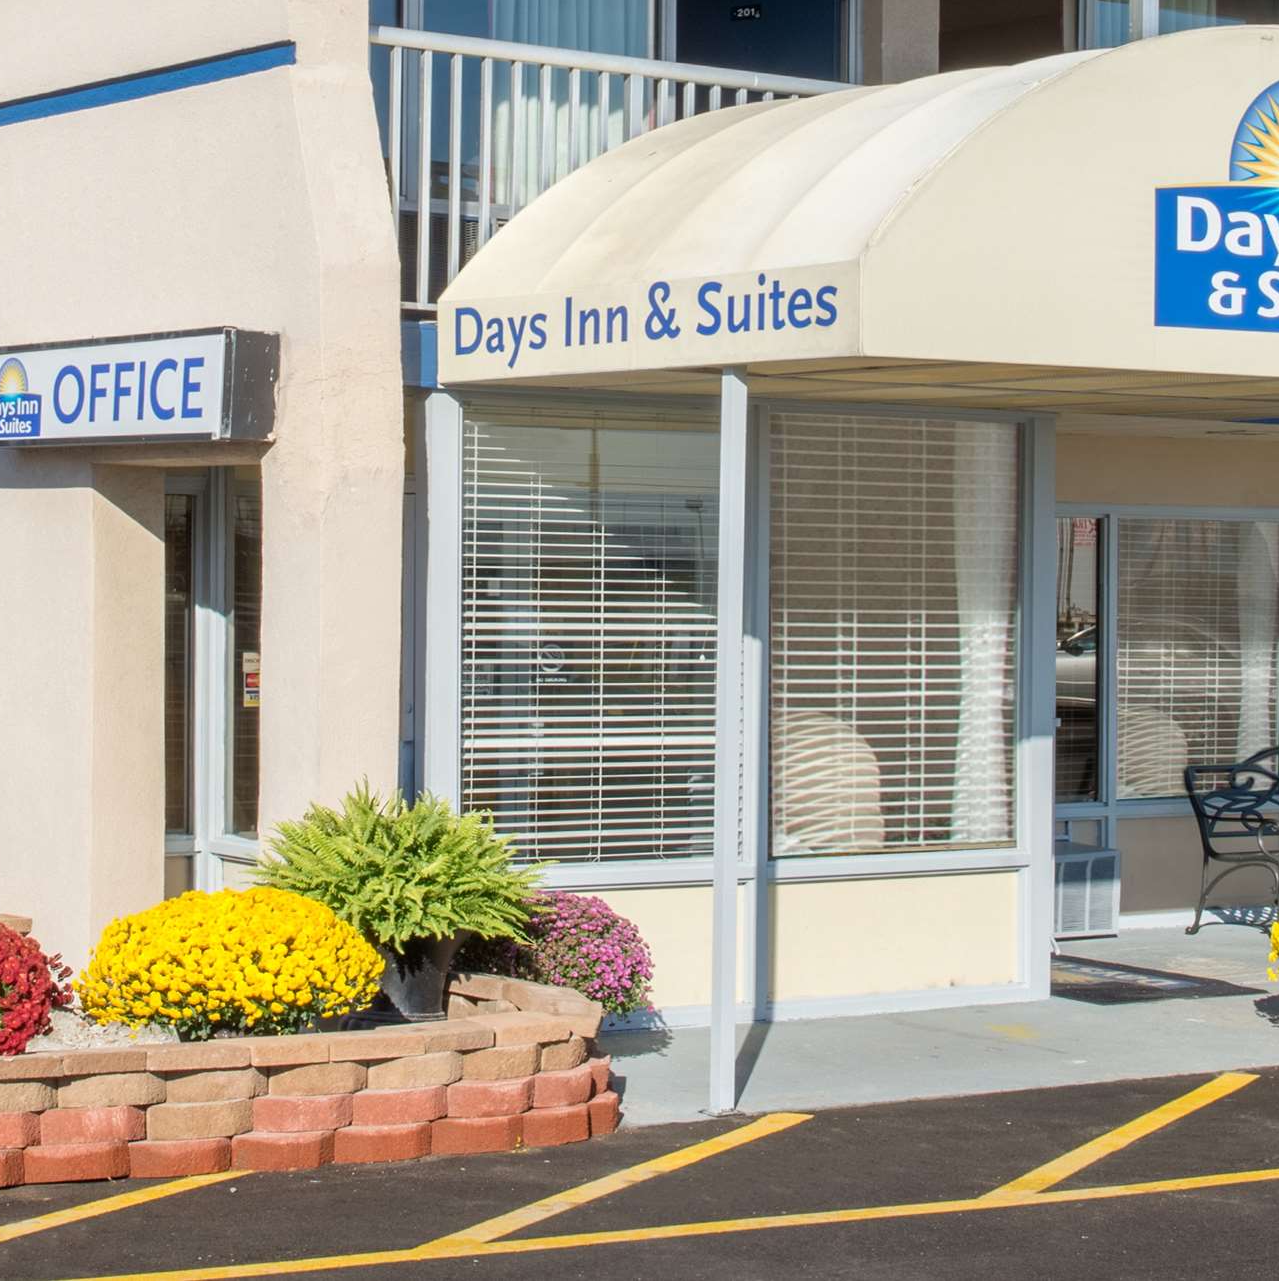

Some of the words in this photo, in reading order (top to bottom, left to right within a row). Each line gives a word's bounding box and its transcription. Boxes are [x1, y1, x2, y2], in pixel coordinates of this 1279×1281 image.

[737, 8, 755, 17] 201
[1208, 271, 1247, 316] &
[454, 306, 548, 369] Days
[564, 296, 629, 348] Inn
[644, 281, 681, 341] &
[695, 273, 839, 336] Suites
[52, 356, 206, 425] OFFICE
[17, 398, 39, 415] Inn
[0, 418, 32, 434] Suites
